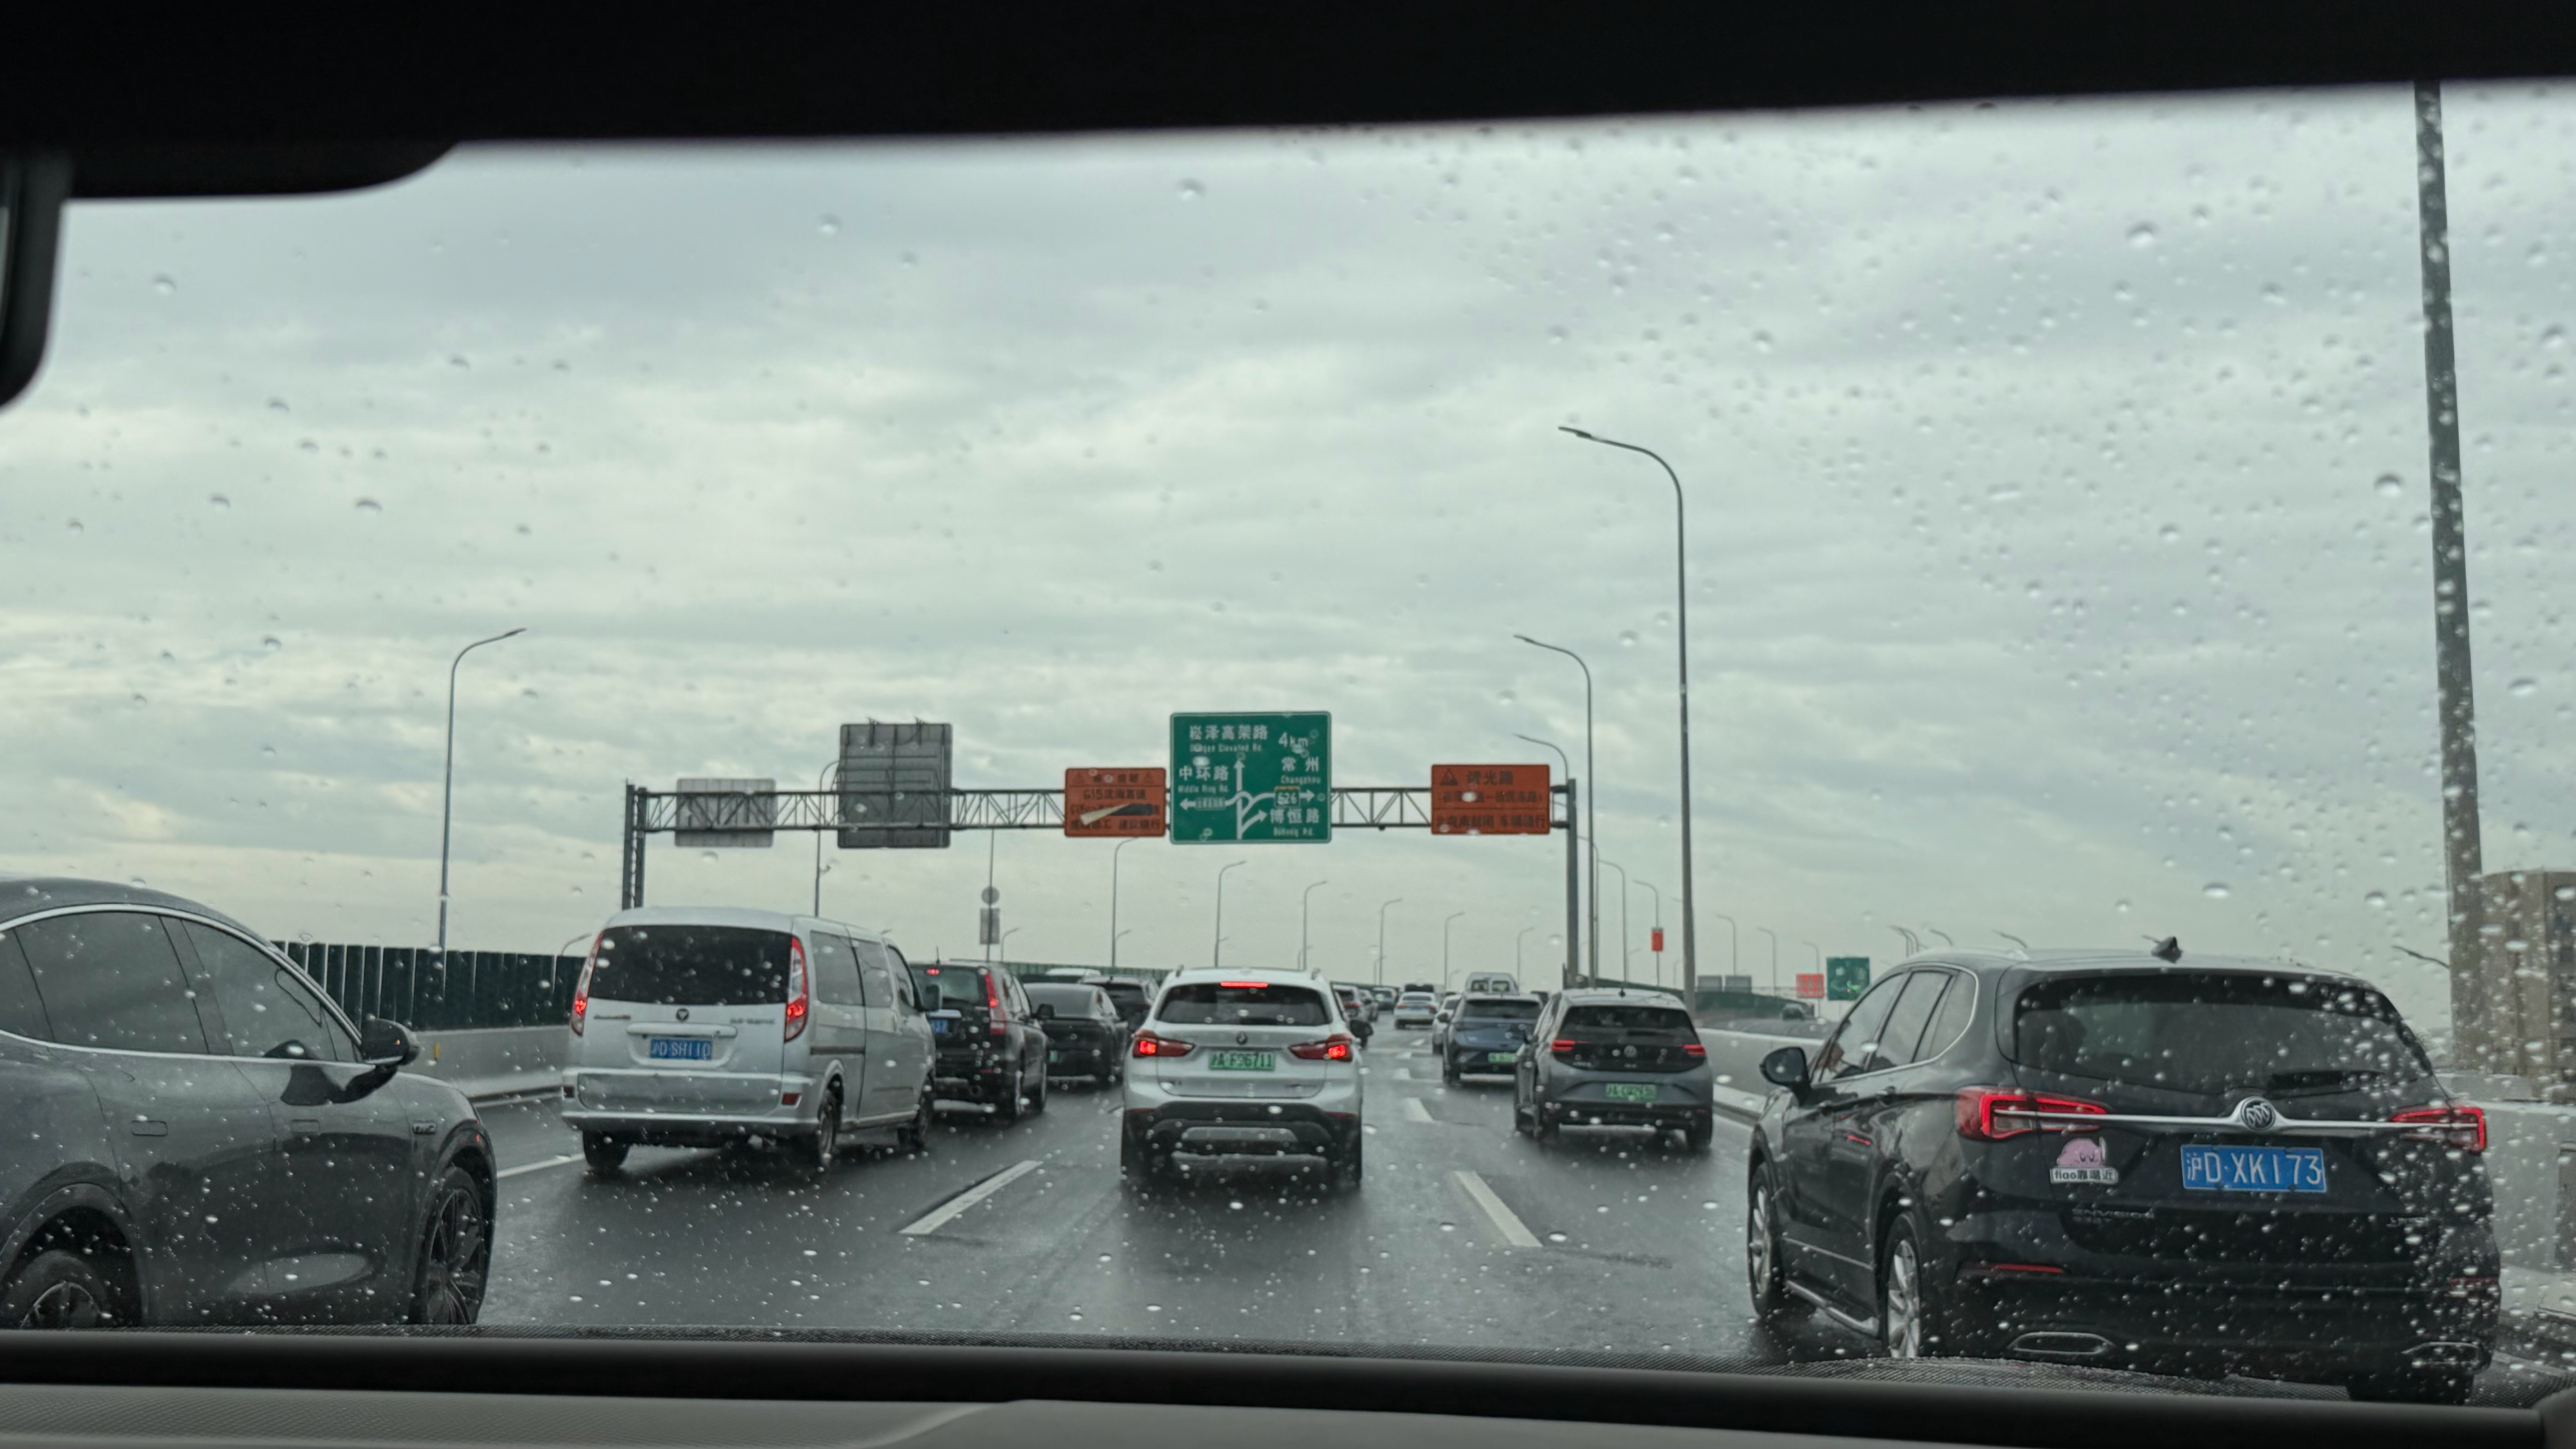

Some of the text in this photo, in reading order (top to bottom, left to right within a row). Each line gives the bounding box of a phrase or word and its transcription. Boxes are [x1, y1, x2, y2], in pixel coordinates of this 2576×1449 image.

[1281, 756, 1320, 773] 常州
[1178, 765, 1229, 781] 中环路
